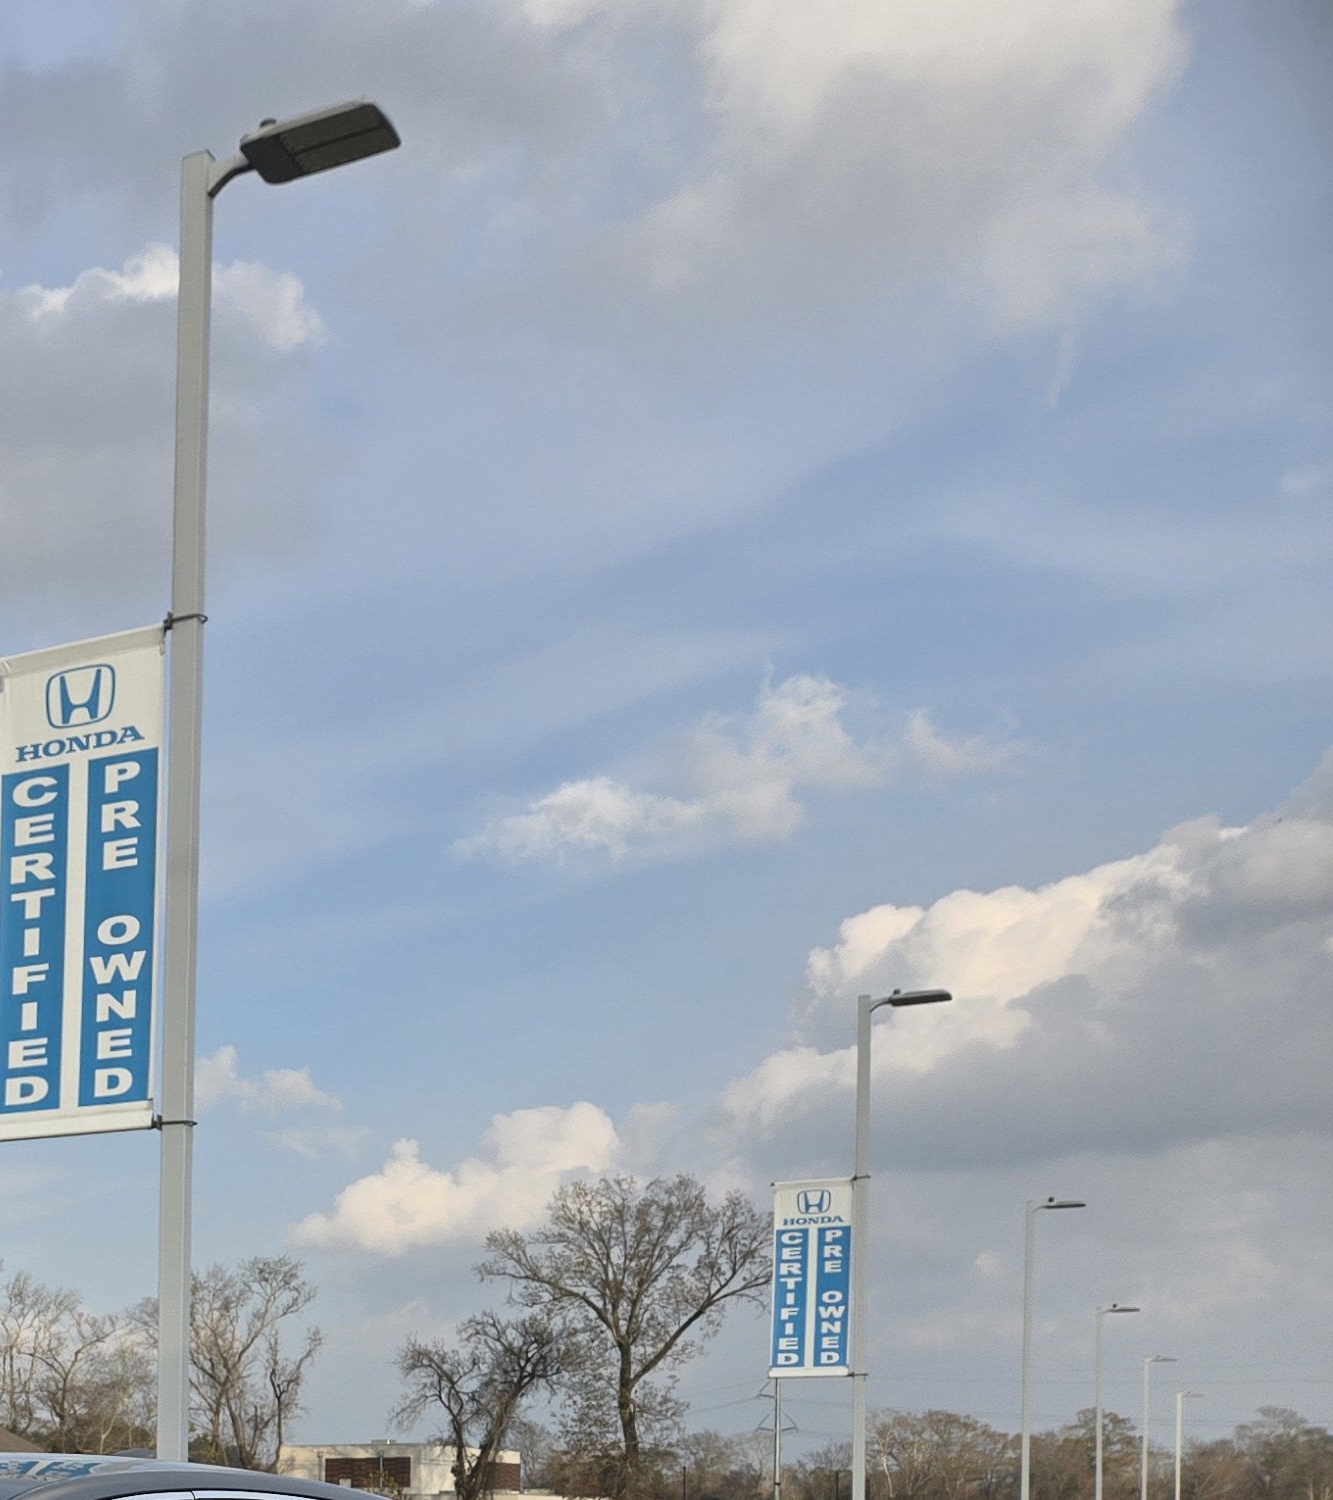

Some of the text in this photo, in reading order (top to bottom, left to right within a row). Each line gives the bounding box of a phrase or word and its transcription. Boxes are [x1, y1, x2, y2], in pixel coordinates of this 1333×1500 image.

[15, 725, 145, 763] HONDA
[4, 776, 58, 1107] CERTIFIED
[89, 761, 147, 1099] PRE OWNED
[783, 1215, 844, 1226] HONDA
[776, 1231, 803, 1366] CERTIFIED
[818, 1229, 845, 1365] PRE OWNED
